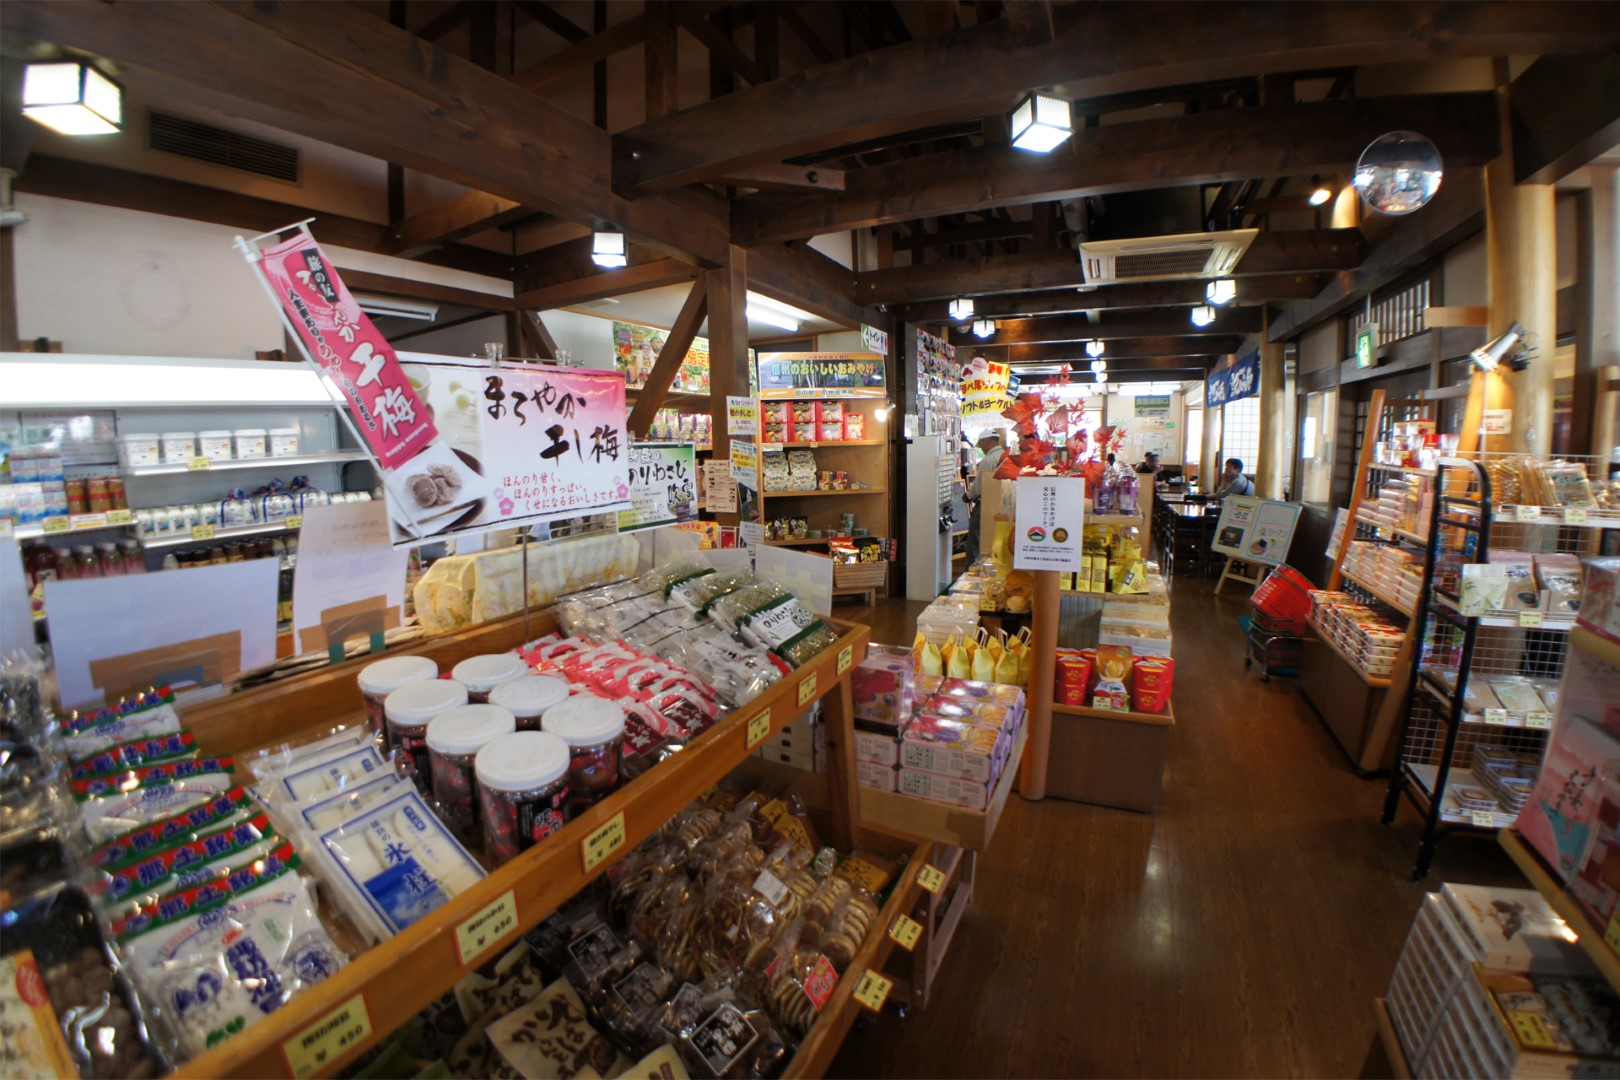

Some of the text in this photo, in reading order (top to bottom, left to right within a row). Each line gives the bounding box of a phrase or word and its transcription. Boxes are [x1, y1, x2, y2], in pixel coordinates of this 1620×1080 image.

[305, 255, 336, 298] 旅の友
[770, 360, 876, 377] 信州のおいしいおみやげ
[539, 424, 622, 468] 干し梅
[503, 471, 562, 488] ほんのり甘く、
[514, 482, 588, 499] ほんのりすっぱい。
[524, 490, 620, 512] くせになるおいしさです。
[132, 792, 238, 852] 郷土銘菓
[137, 821, 262, 888] 郷土銘菓
[158, 854, 287, 922] 郷土銘菓
